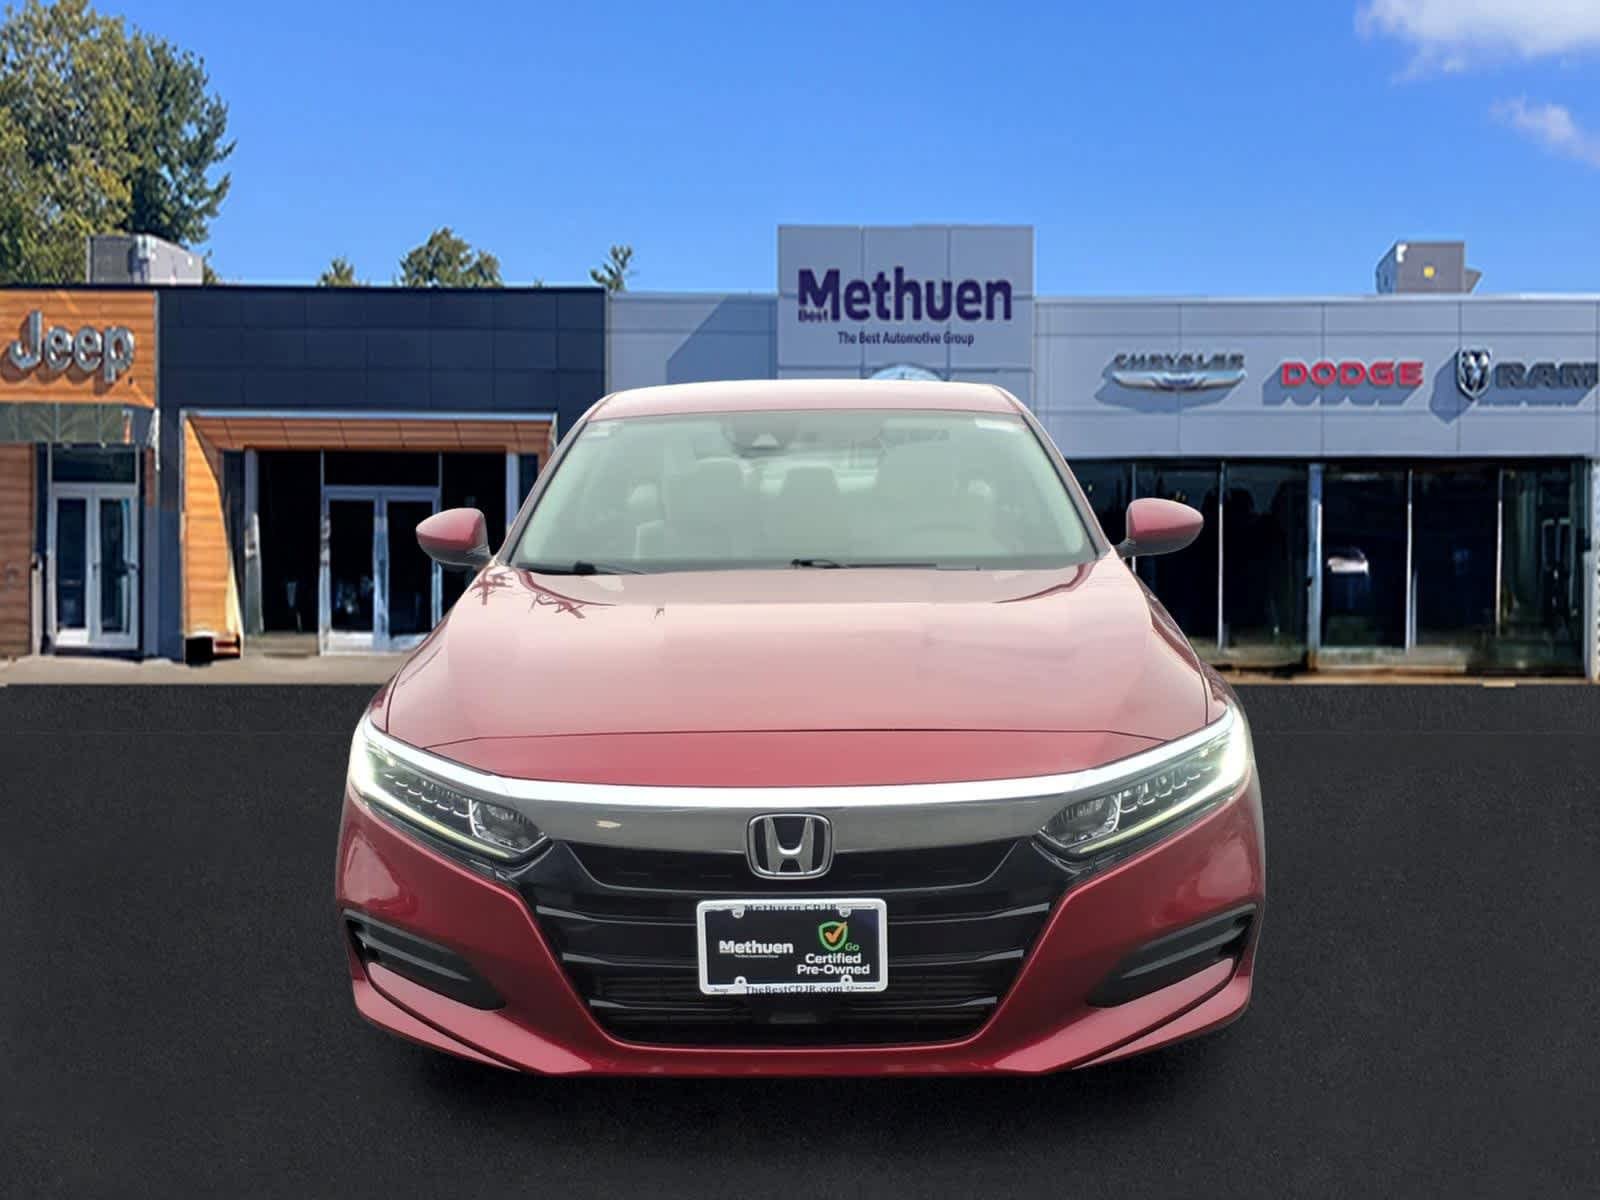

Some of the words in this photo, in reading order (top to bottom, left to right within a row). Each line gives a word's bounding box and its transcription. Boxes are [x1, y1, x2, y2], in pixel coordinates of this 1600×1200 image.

[798, 266, 1012, 321] Methuen
[9, 310, 135, 383] Jeep
[837, 331, 857, 344] The
[859, 331, 880, 344] Best
[883, 331, 941, 344] Automotive
[943, 331, 975, 347] Group
[1113, 352, 1245, 370] CHRYSLER
[1281, 360, 1424, 386] DODGE
[1495, 362, 1599, 388] RAM
[719, 940, 794, 954] Methuen
[845, 942, 860, 952] Go
[805, 952, 862, 965] Certified
[796, 963, 871, 975] Pre-Owned
[744, 984, 843, 994] TheBestCDJR.com
